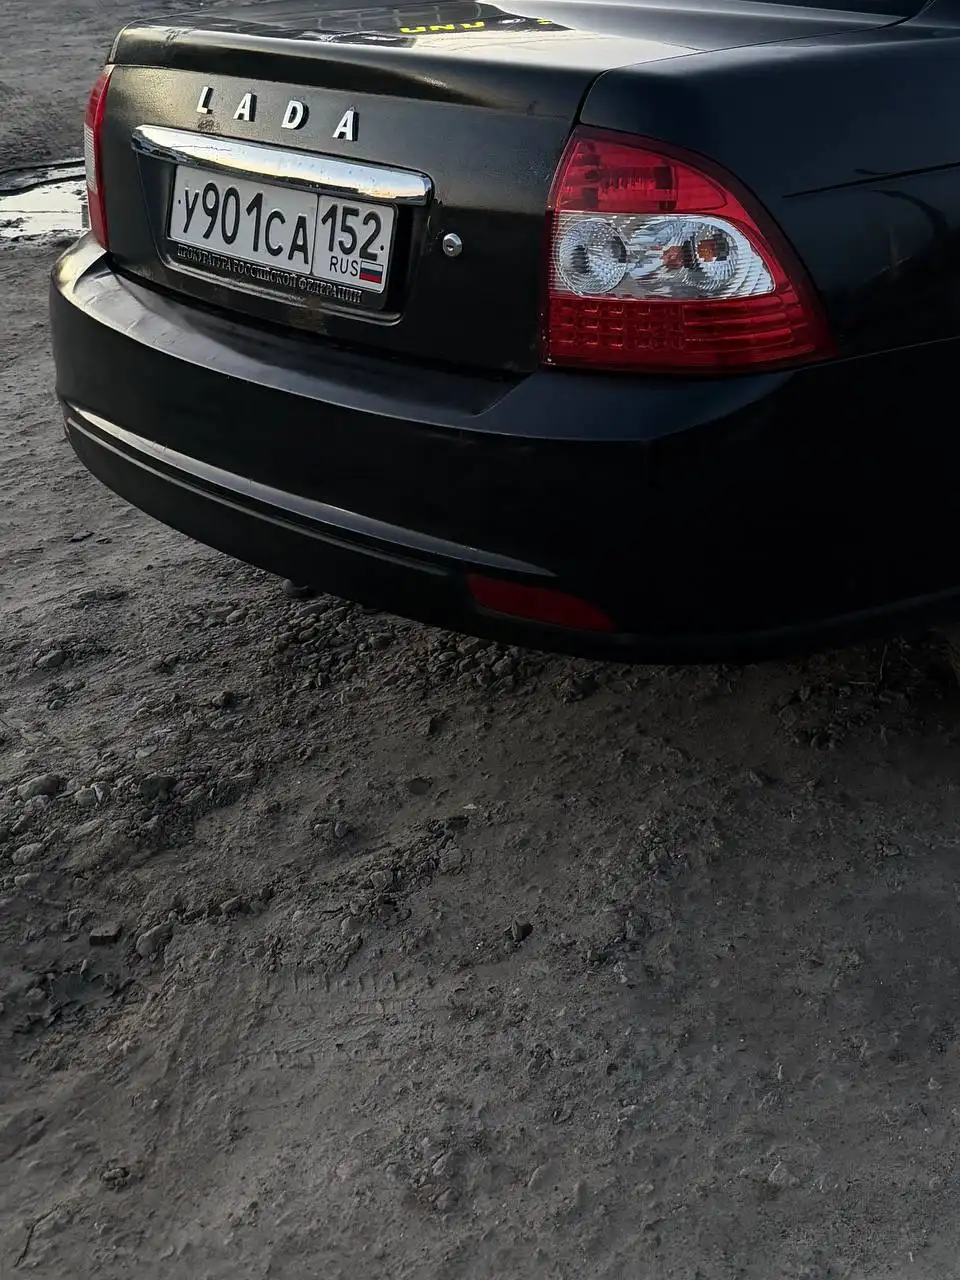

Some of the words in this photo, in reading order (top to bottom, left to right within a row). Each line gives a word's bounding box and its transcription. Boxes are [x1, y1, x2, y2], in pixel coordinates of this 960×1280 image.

[197, 86, 361, 141] LADA
[183, 183, 309, 265] У901СА
[321, 204, 383, 261] 152
[177, 244, 232, 272] ПРОКУРАТУРА
[232, 259, 297, 289] РОССИЙСКОЙ
[298, 277, 362, 304] ФЕДЕРАЦИИ
[329, 256, 359, 276] RUS
